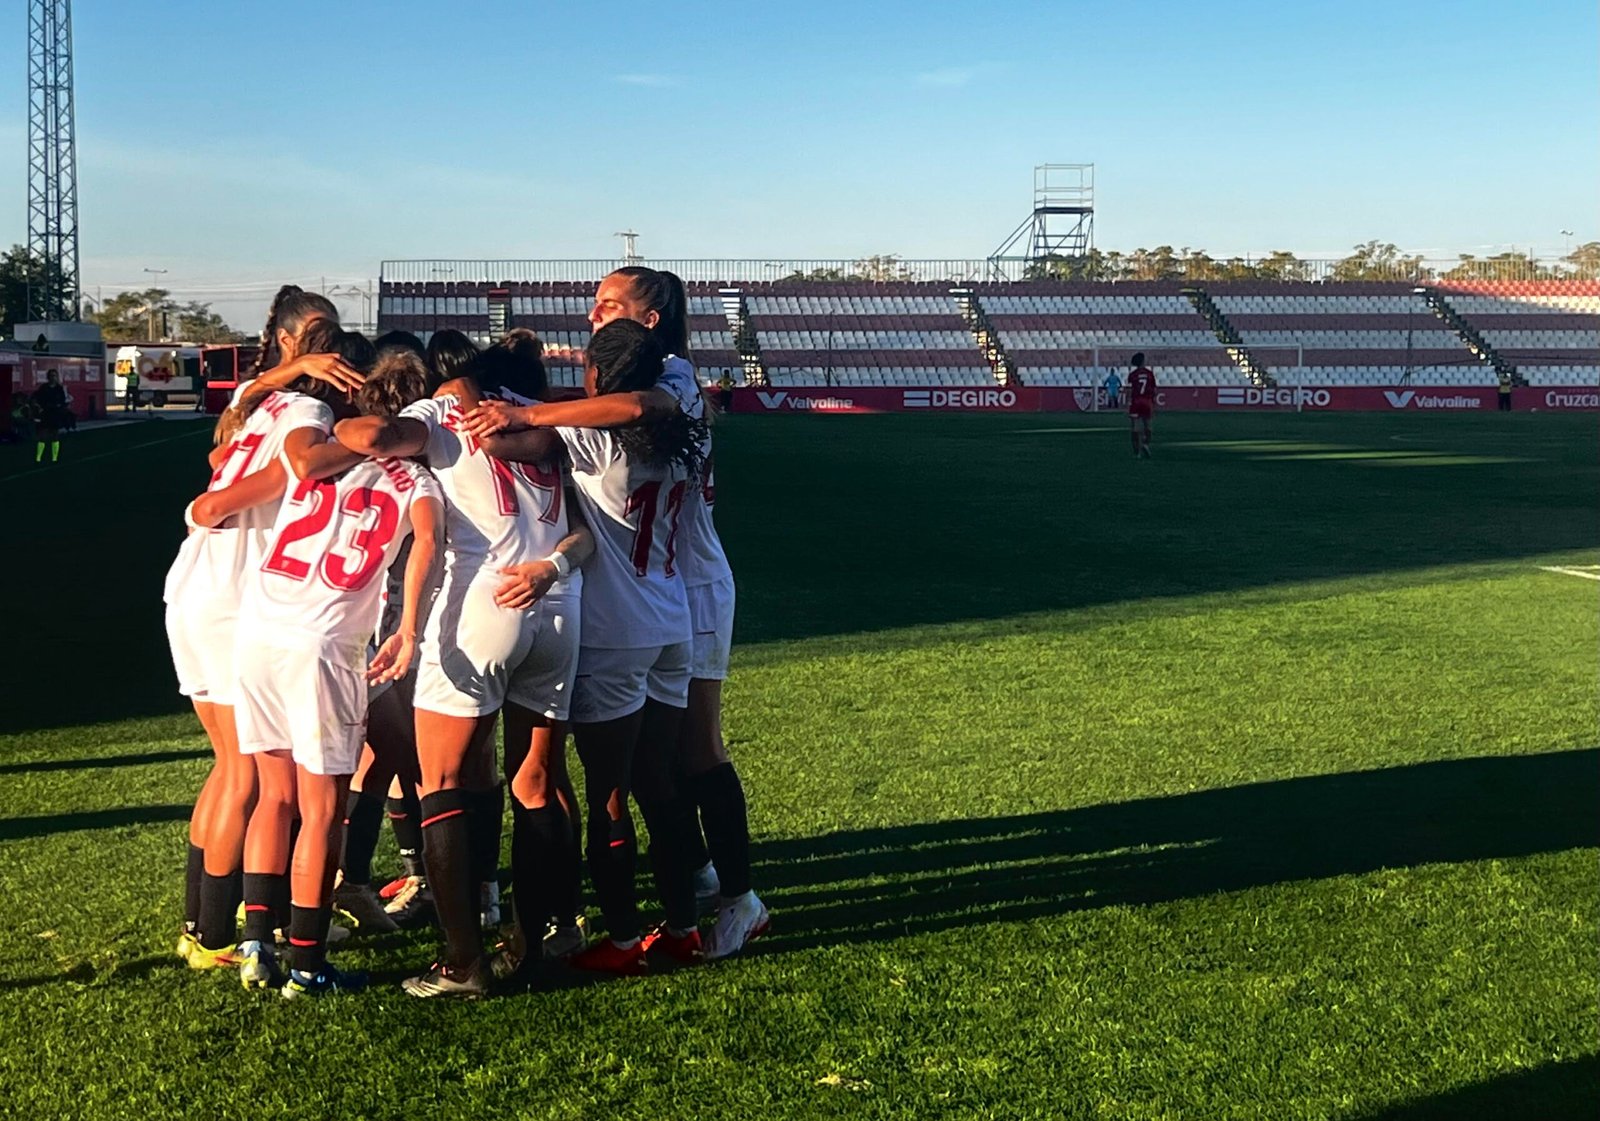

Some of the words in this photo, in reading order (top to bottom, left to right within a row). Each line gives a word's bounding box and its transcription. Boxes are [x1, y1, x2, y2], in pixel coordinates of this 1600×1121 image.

[1138, 379, 1148, 395] 7
[788, 397, 854, 409] Valvoline
[932, 390, 1016, 407] DEGIRO
[1246, 389, 1331, 407] DEGIRO
[1414, 396, 1481, 408] Valvoline
[260, 478, 400, 592] 23
[623, 480, 686, 579] 11
